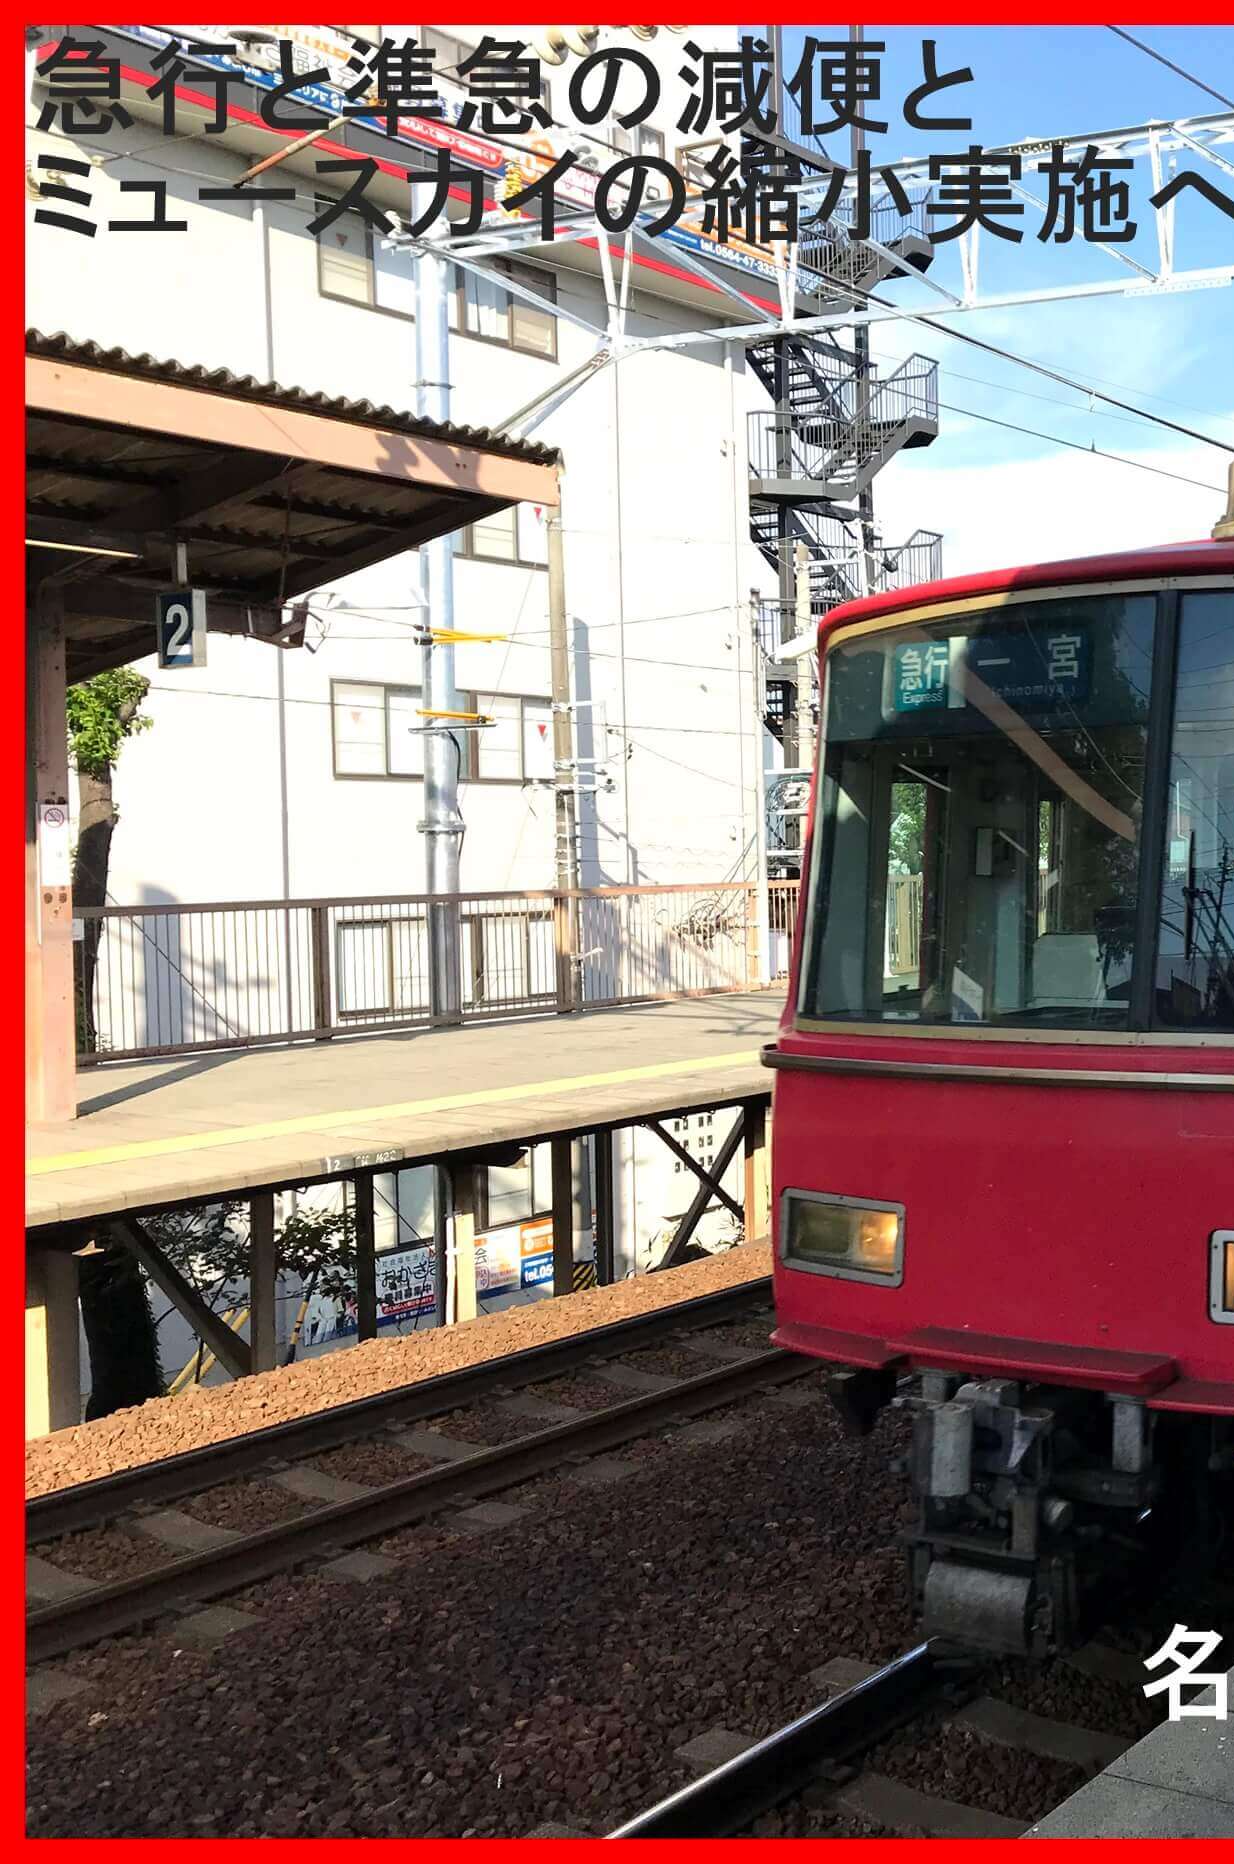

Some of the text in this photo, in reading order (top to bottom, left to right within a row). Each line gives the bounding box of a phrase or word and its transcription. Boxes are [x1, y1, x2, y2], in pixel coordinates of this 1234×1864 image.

[165, 603, 192, 657] 2
[900, 646, 948, 690] 急行
[976, 633, 1081, 680] 一宮
[902, 690, 944, 706] Express
